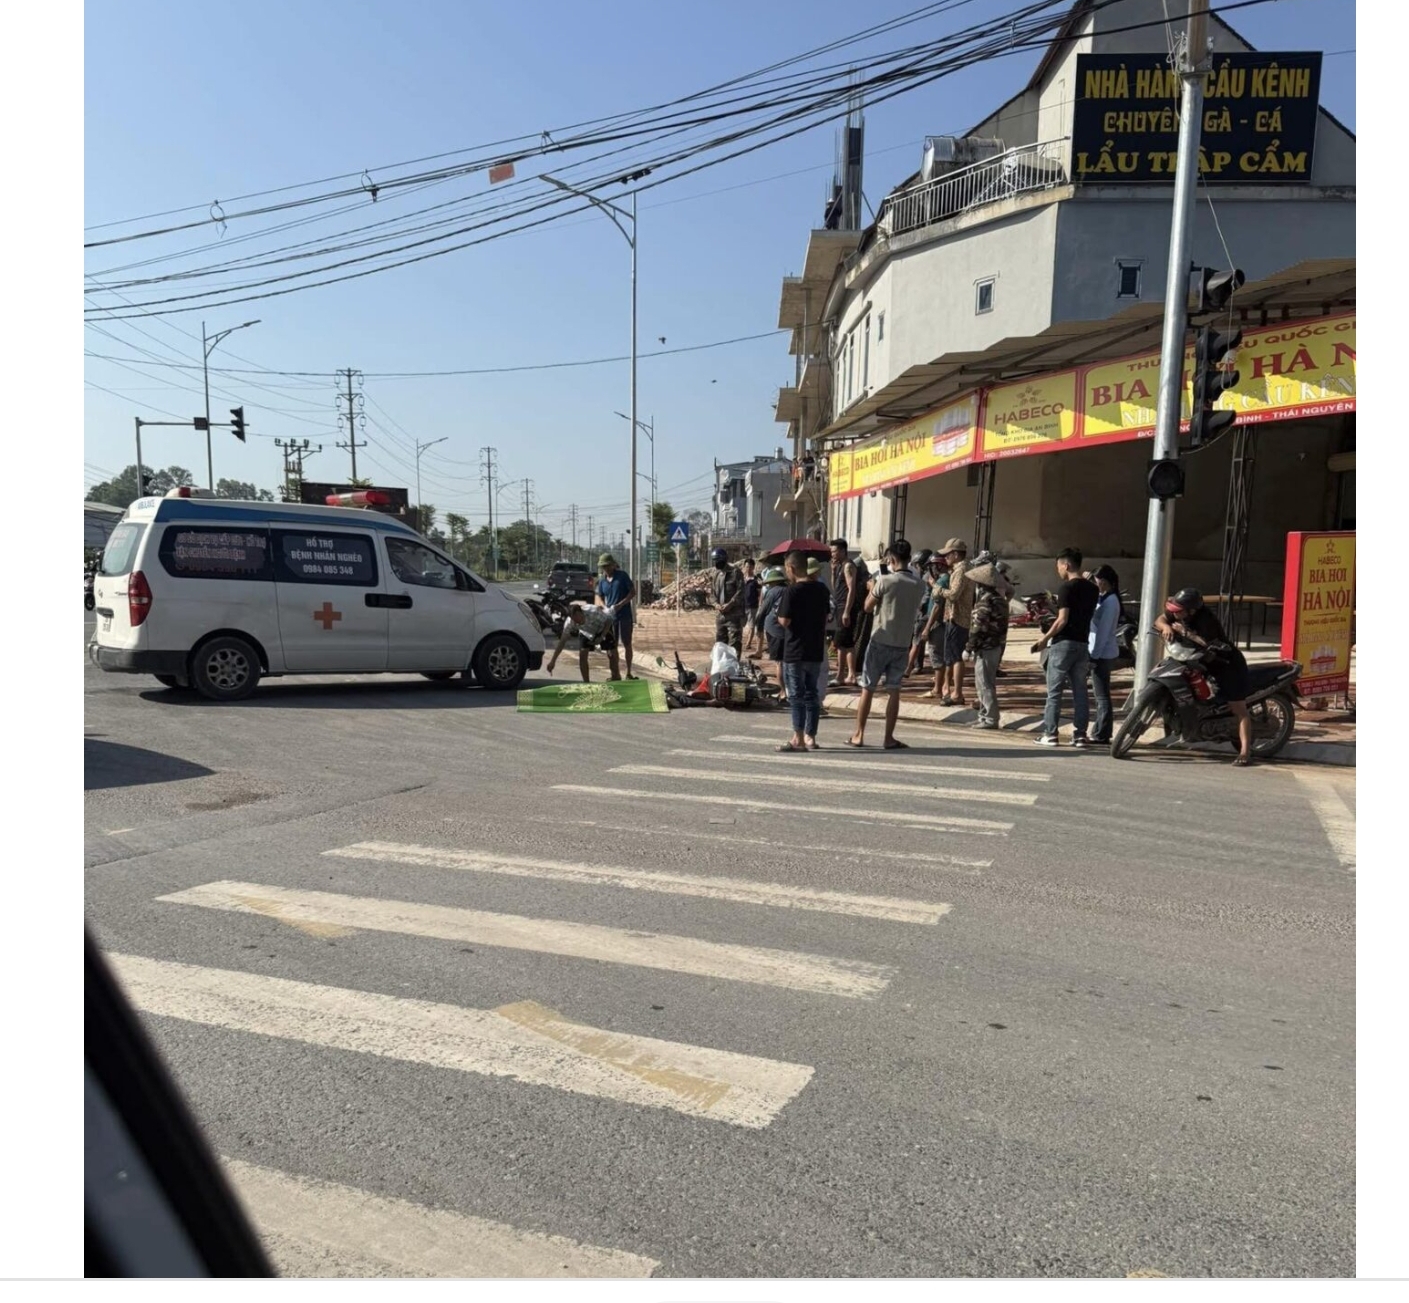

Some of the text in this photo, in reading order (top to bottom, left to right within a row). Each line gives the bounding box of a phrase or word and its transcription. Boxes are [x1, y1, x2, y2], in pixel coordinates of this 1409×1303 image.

[1085, 63, 1130, 99] NHÀ
[1136, 63, 1178, 99] HÀN
[1251, 62, 1310, 99] KÊNH
[1204, 106, 1232, 133] GÀ
[1255, 106, 1283, 133] CÁ
[1264, 325, 1328, 344] QUỐC
[1091, 379, 1152, 408] BIA
[1250, 343, 1319, 380] HÀ
[1300, 373, 1356, 402] KÊN
[994, 402, 1065, 426] HABECO
[1236, 412, 1262, 424] BÌNH
[1273, 409, 1299, 420] THÁI
[1302, 402, 1354, 416] NGUYÊN
[855, 458, 869, 471] BIA
[1318, 556, 1341, 565] HABECO
[1309, 569, 1326, 584] BIA
[1303, 585, 1351, 613] HÀ NỘI
